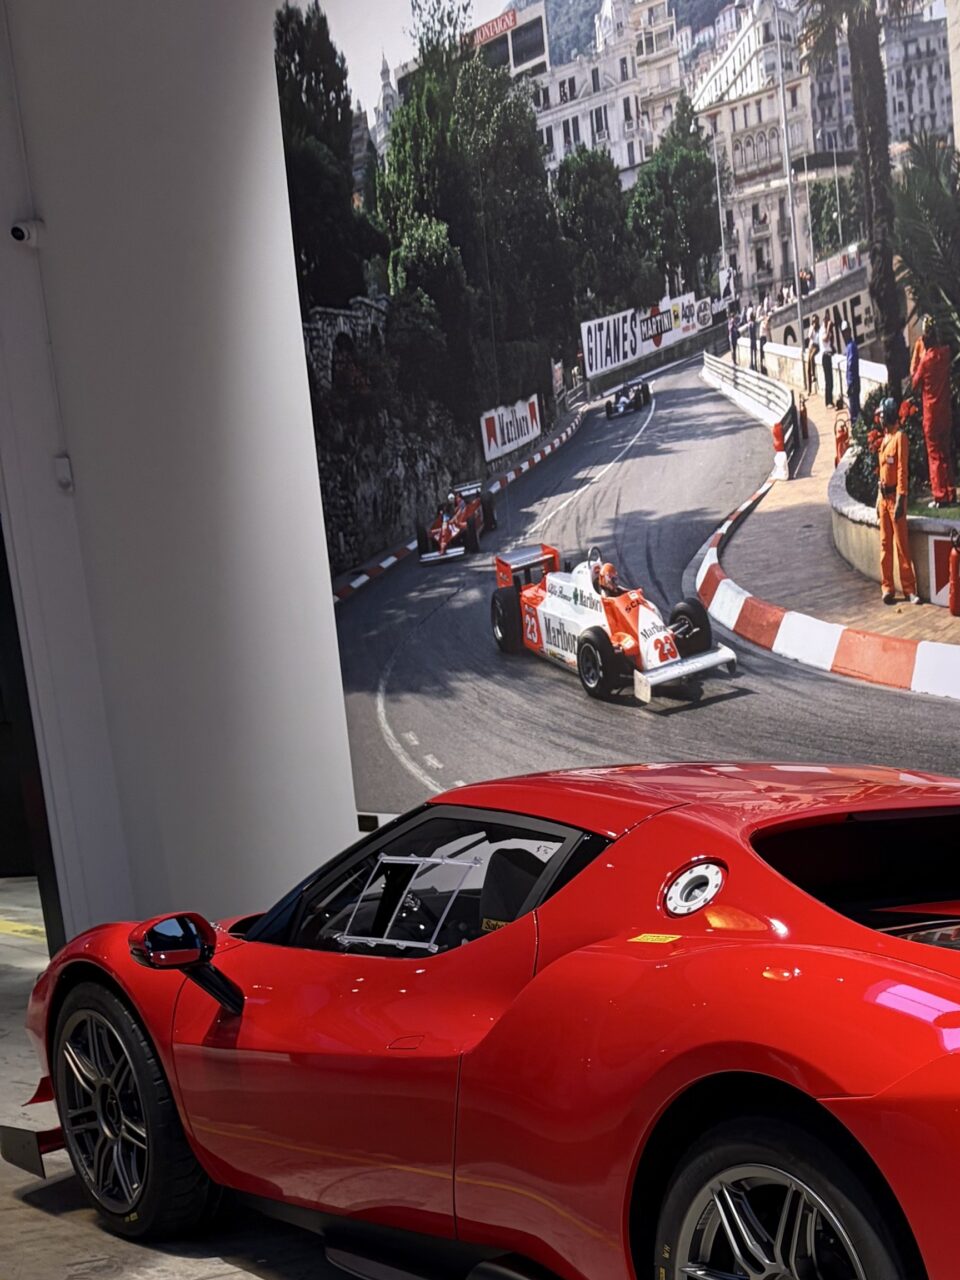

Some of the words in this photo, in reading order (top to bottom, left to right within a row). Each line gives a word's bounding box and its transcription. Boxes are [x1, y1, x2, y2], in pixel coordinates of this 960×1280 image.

[641, 310, 671, 340] MARTINI
[587, 311, 637, 372] GITANES
[525, 614, 538, 643] 23
[544, 616, 578, 655] Marlbor
[654, 635, 678, 663] 23
